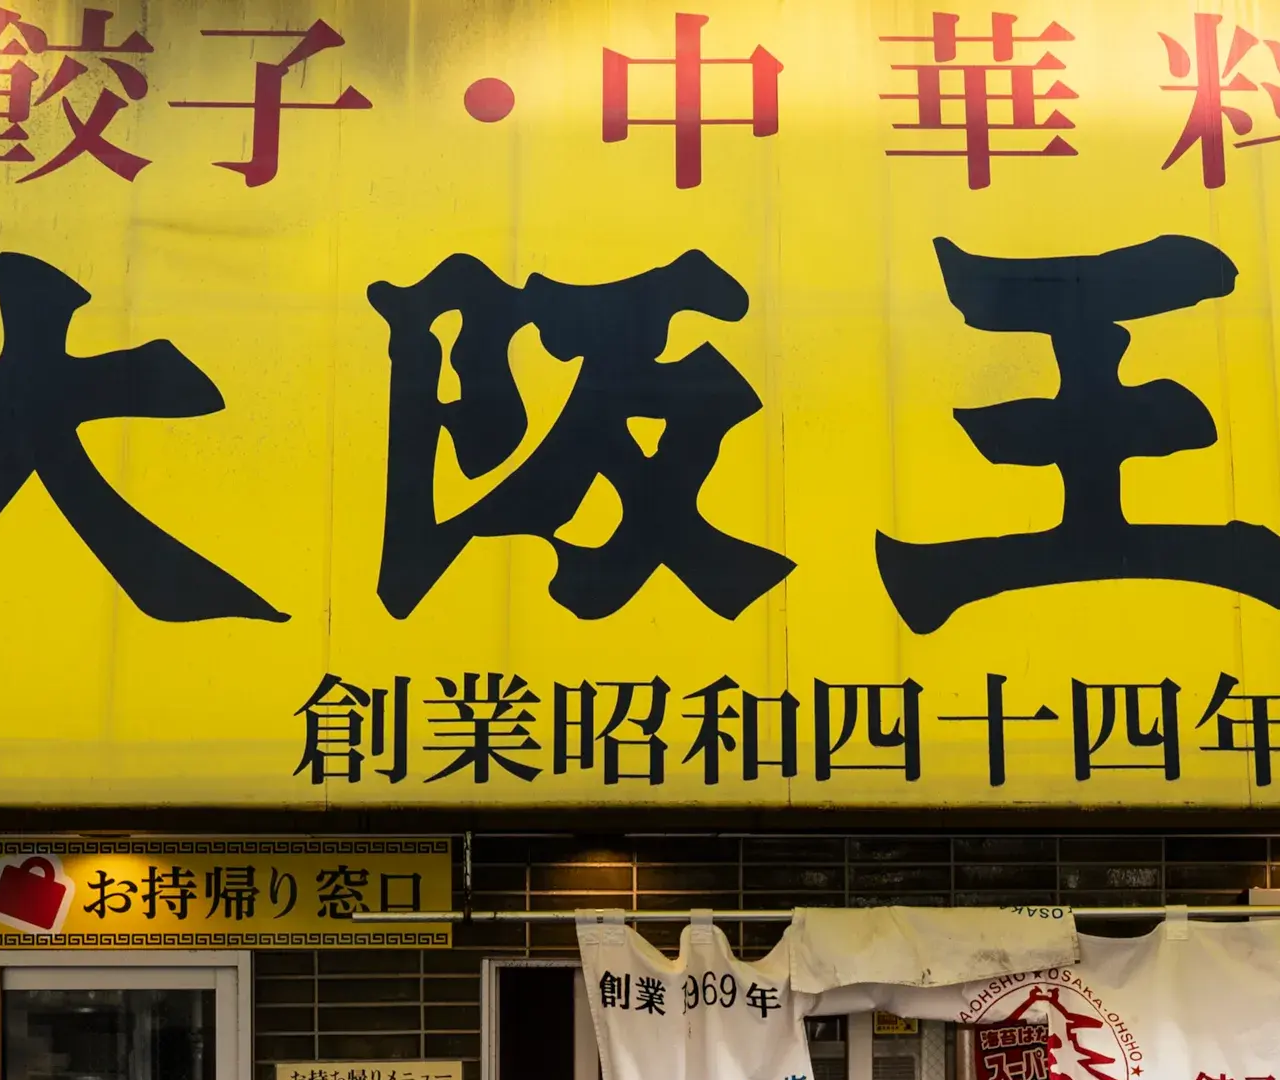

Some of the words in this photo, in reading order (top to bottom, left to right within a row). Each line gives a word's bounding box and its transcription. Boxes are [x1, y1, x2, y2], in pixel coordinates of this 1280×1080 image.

[83, 865, 422, 921] お持帰り窓口
